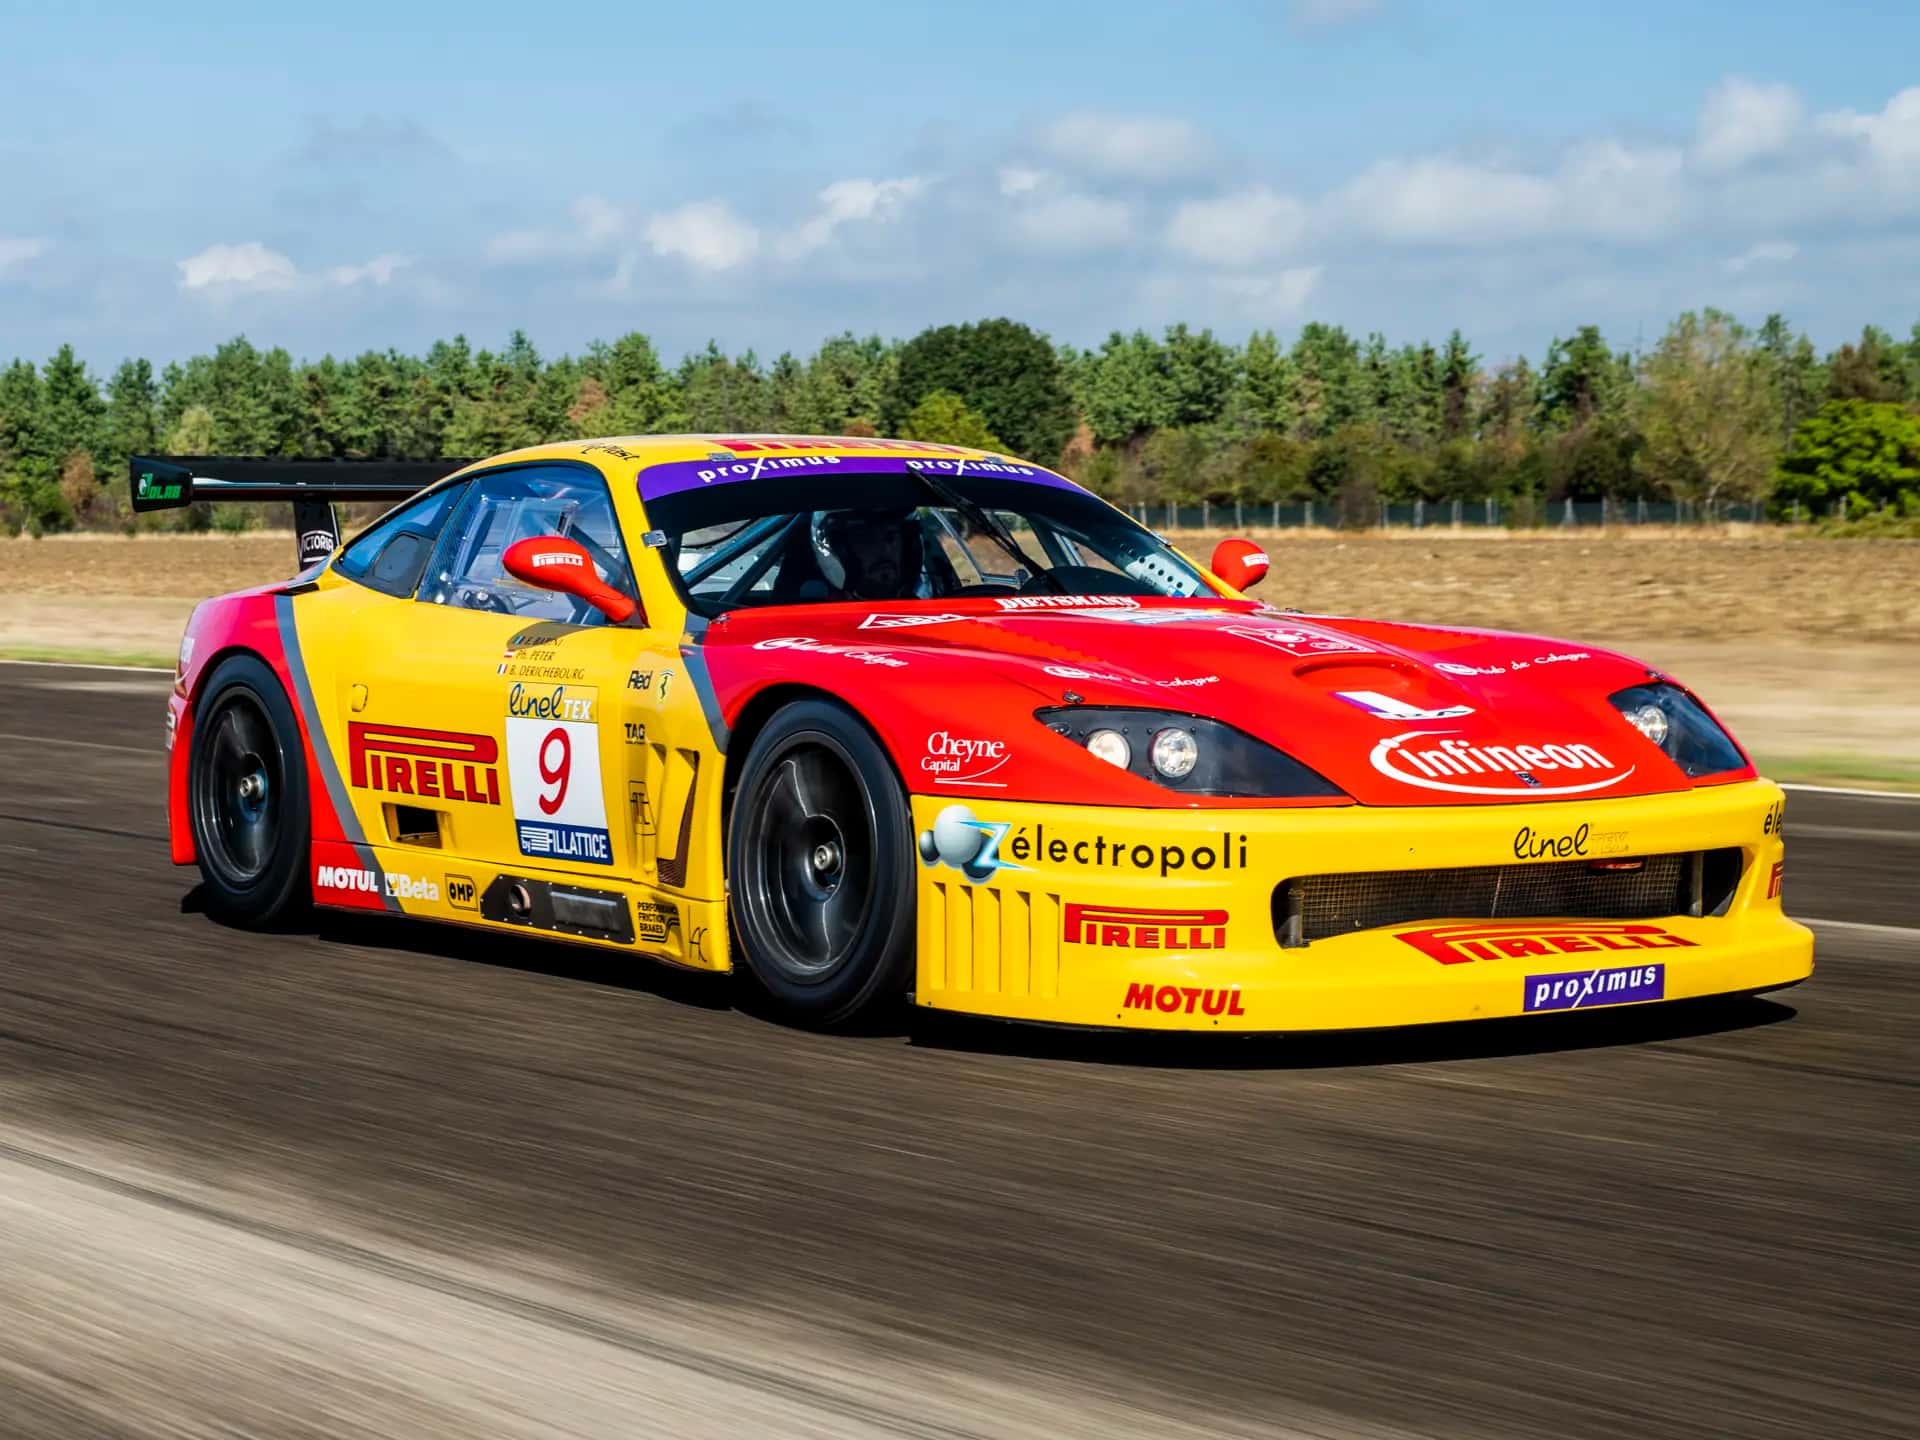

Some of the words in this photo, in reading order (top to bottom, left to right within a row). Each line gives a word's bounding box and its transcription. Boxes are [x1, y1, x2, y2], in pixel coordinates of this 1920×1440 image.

[697, 454, 841, 482] proximus
[906, 458, 1035, 477] proximus
[532, 552, 584, 567] PIRELLI
[624, 723, 646, 739] TAG
[927, 731, 1005, 763] Cheyne
[1397, 740, 1615, 777] Infineon
[348, 721, 501, 805] PIRELLI
[539, 727, 571, 816] 9
[921, 756, 960, 774] Capital
[545, 829, 608, 859] FILLATTICE
[1011, 823, 1247, 877] électropoli
[317, 865, 379, 893] MOTUL
[398, 873, 440, 901] Beta
[449, 882, 474, 902] OMP
[1063, 902, 1230, 949] PIRELLI
[1391, 923, 1702, 965] PIRELLI
[1123, 982, 1246, 1016] MOTUL
[1533, 966, 1657, 1009] proximus
